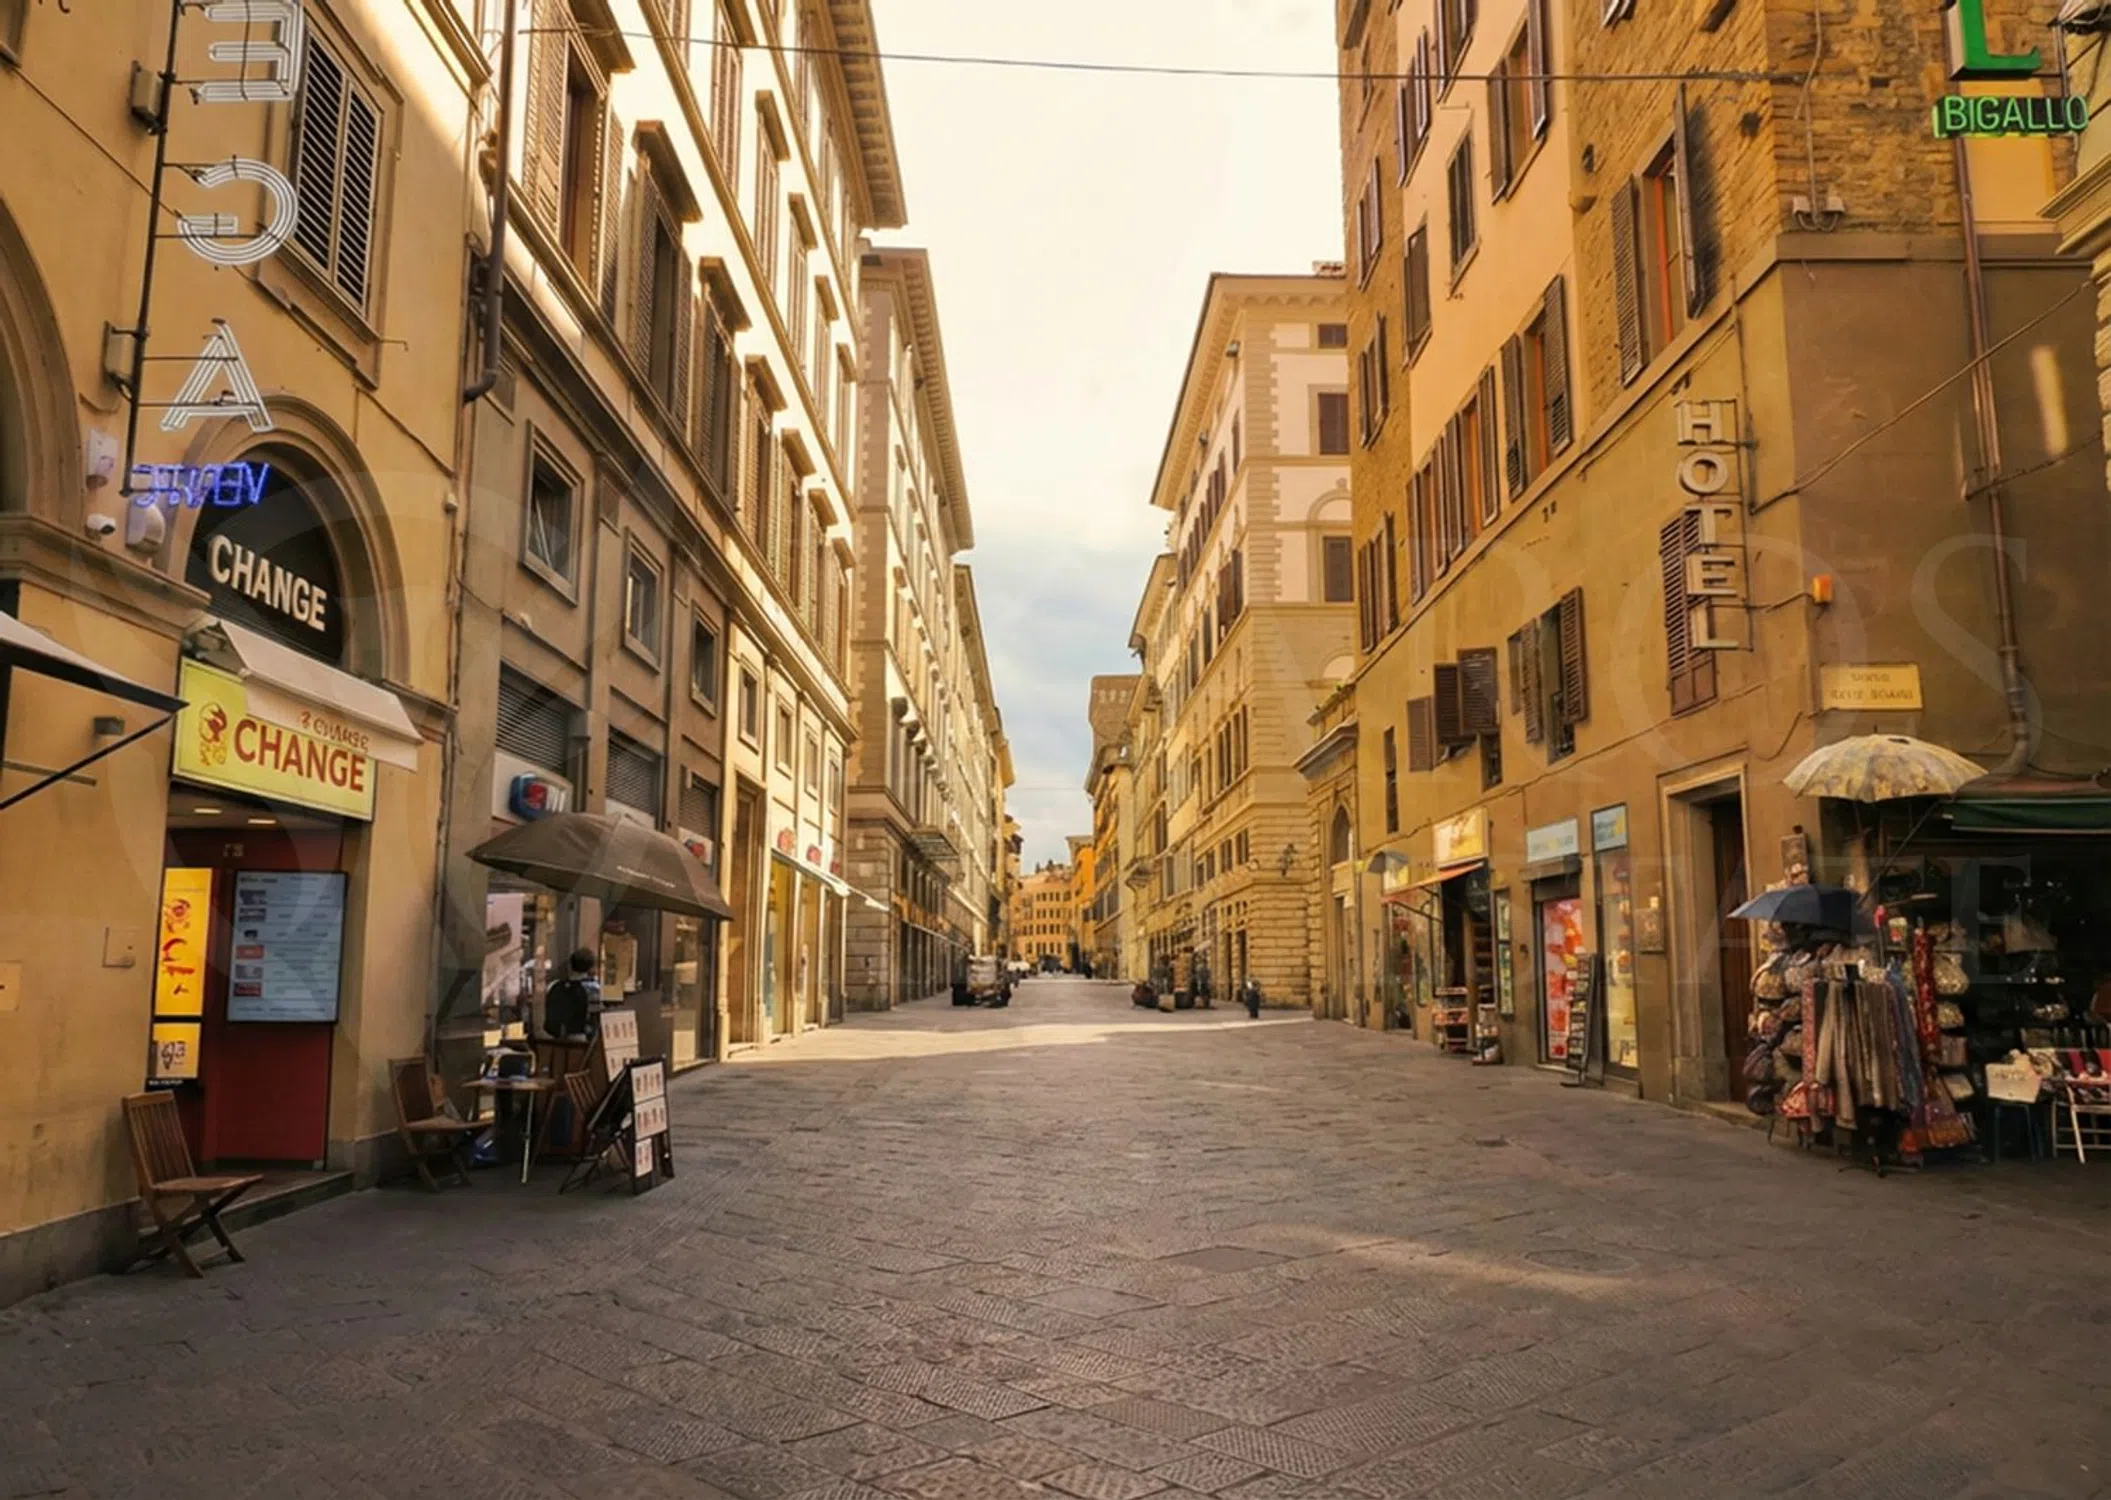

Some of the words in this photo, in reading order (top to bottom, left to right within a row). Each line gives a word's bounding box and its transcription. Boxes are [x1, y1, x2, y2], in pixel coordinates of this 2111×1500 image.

[1942, 94, 2090, 132] BIGALLO
[1675, 399, 1740, 652] HOTEL
[208, 532, 327, 633] CHANGE
[233, 718, 366, 795] CHANGE
